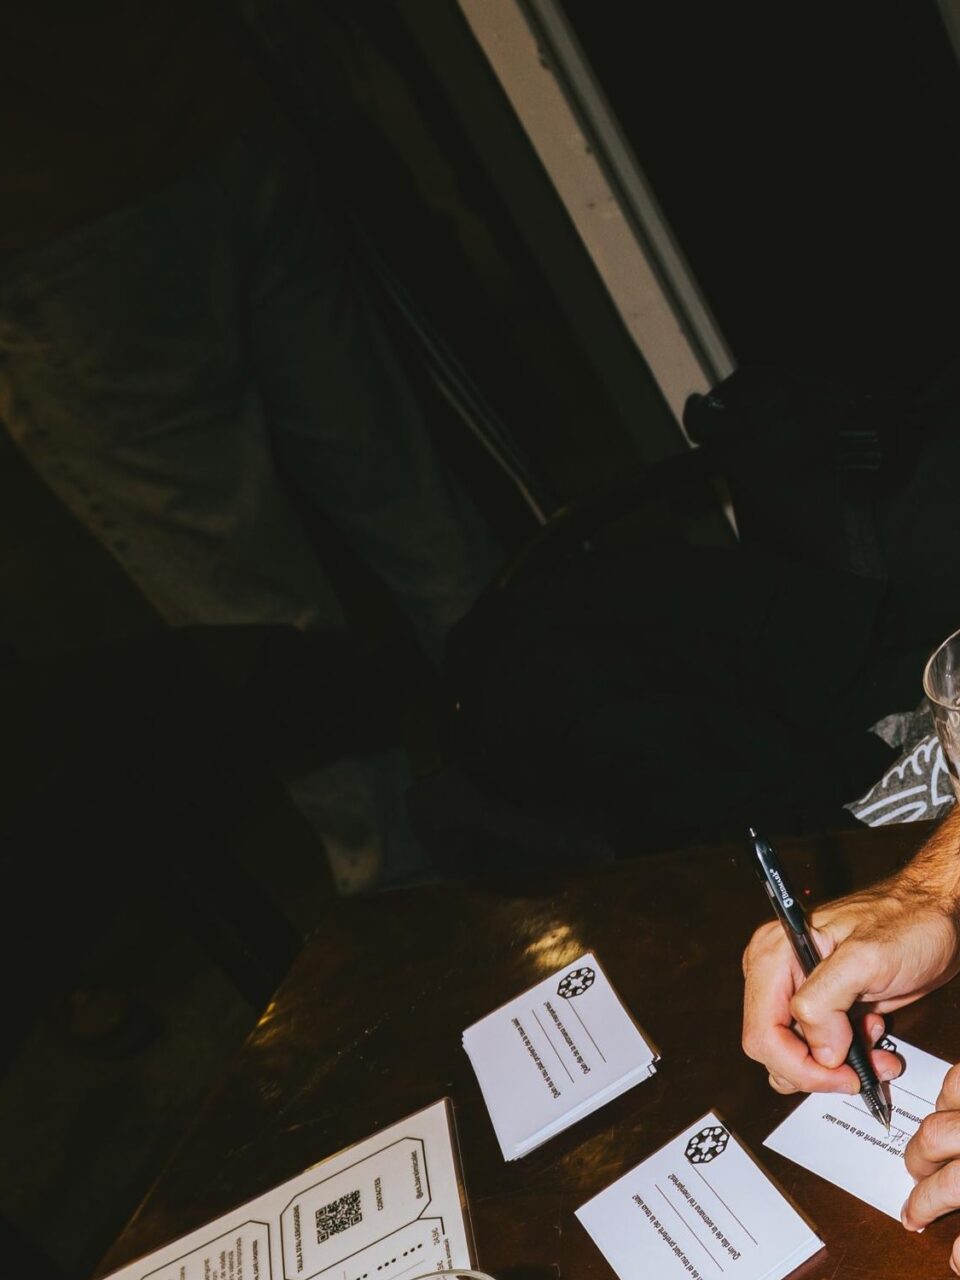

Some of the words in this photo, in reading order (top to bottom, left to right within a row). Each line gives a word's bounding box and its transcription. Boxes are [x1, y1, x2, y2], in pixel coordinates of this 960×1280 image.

[821, 1113, 837, 1123] iaia?
[835, 1119, 850, 1130] teua
[849, 1126, 857, 1134] la
[855, 1129, 865, 1137] de
[863, 1133, 889, 1149] preferit
[886, 1145, 901, 1155] plat
[667, 1173, 691, 1199] menjaries?
[374, 1177, 383, 1210] CONTACTES
[631, 1194, 644, 1207] iaia?
[687, 1197, 697, 1207] t'el
[640, 1204, 652, 1217] teua
[694, 1204, 714, 1227] setmana
[649, 1214, 656, 1223] la
[652, 1219, 661, 1228] de
[711, 1225, 718, 1233] la
[657, 1226, 676, 1247] preferit
[715, 1230, 723, 1239] de
[720, 1237, 730, 1247] dia
[671, 1245, 684, 1257] plat
[727, 1245, 741, 1260] Quin
[680, 1255, 690, 1266] teu
[690, 1269, 699, 1278] és
